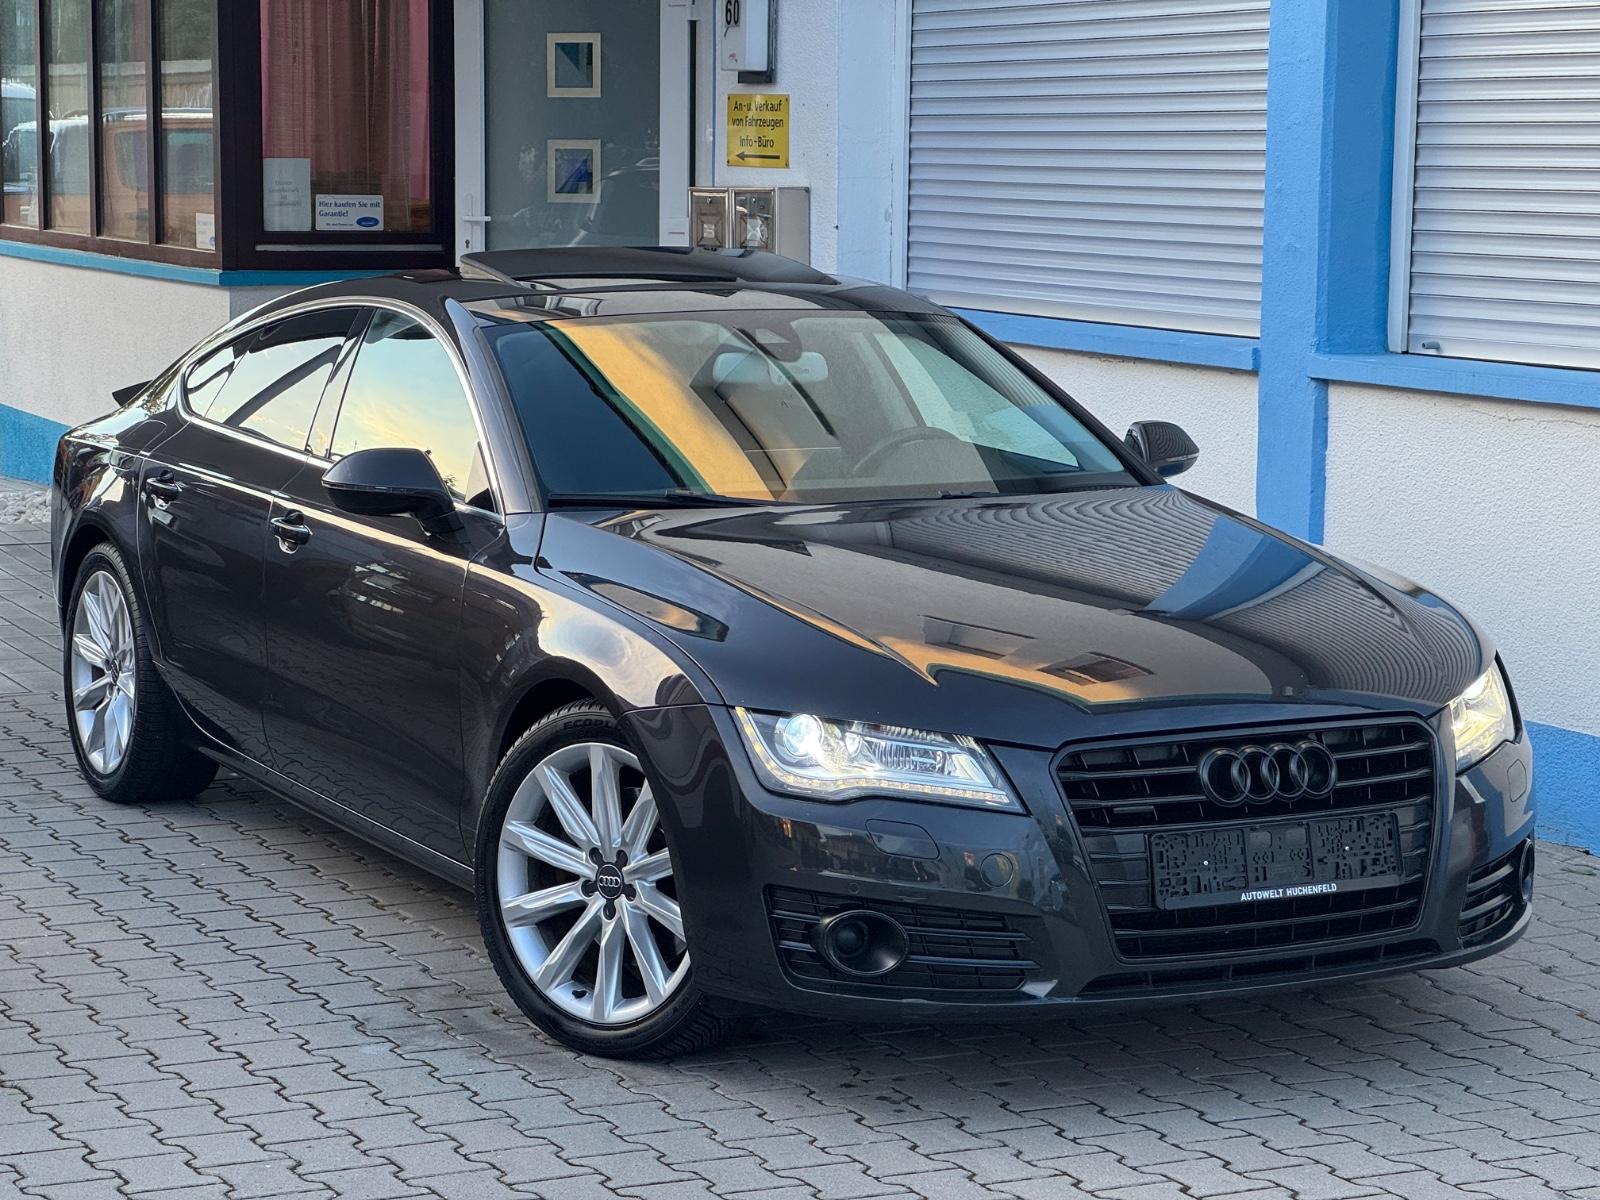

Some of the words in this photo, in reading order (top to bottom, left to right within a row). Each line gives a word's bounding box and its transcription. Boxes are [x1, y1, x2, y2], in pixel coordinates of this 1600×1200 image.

[725, 0, 740, 25] 60
[754, 100, 782, 111] Verkauf
[732, 117, 744, 127] von
[745, 116, 784, 130] Fahrzeugen
[319, 200, 333, 208] Hier
[358, 200, 368, 208] Sie
[1240, 889, 1284, 901] AUTOWELT
[1286, 883, 1337, 897] HUCHENFELD
